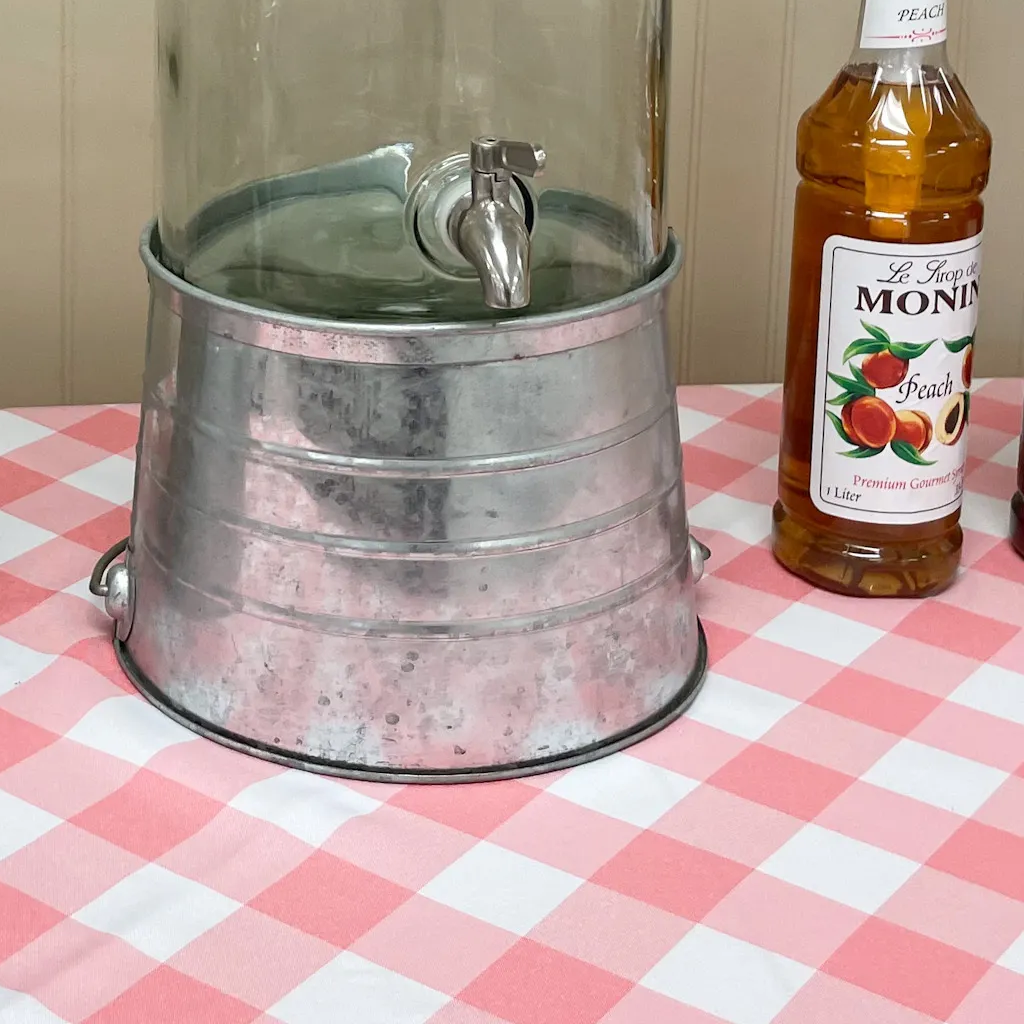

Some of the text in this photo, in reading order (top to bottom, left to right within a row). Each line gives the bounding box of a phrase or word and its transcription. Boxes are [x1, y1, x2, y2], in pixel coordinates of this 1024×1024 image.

[897, 2, 945, 23] PEACH
[876, 261, 913, 284] Le
[916, 259, 964, 288] Sirop
[854, 273, 980, 316] MONIN
[895, 371, 953, 404] Peach
[853, 474, 907, 491] Premium
[910, 471, 951, 490] Gourmet
[835, 486, 862, 502] Liter
